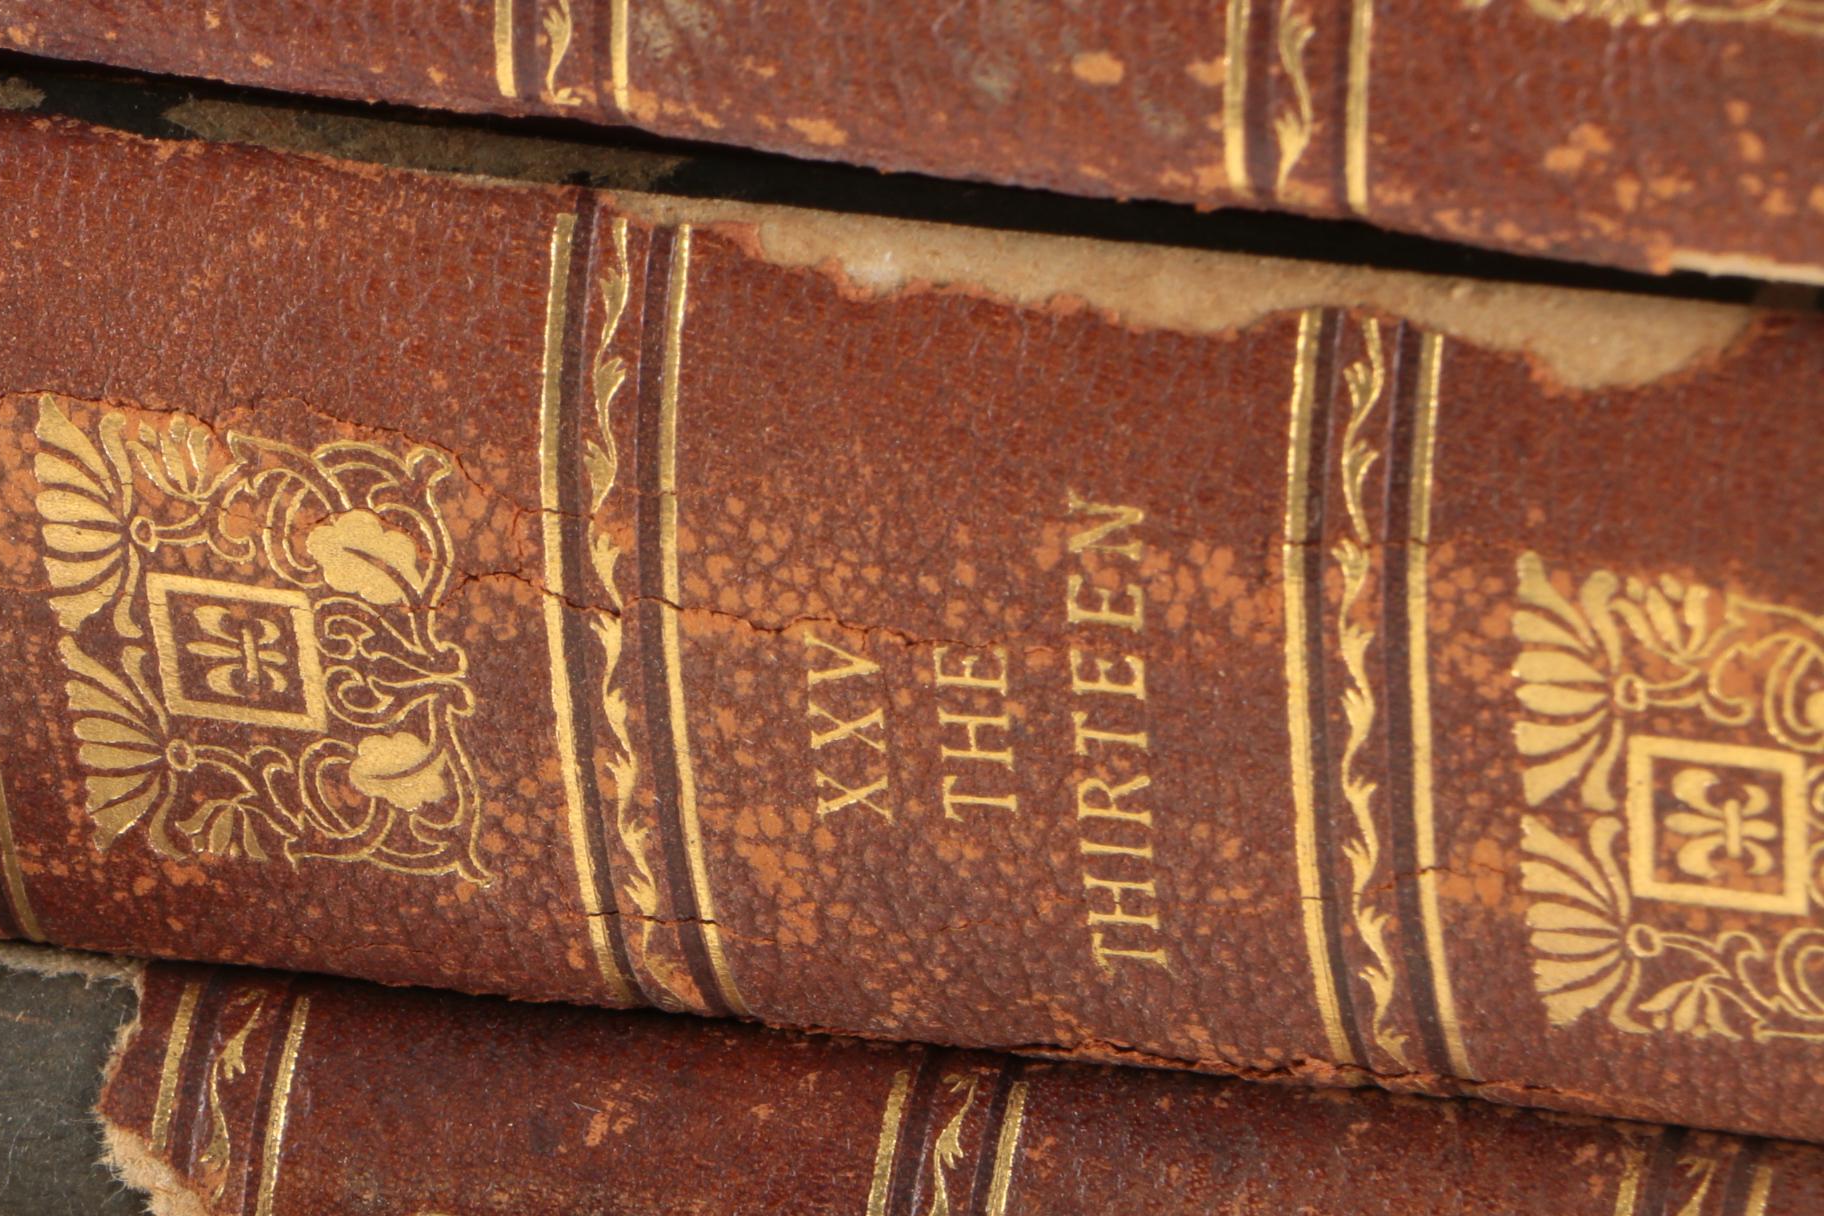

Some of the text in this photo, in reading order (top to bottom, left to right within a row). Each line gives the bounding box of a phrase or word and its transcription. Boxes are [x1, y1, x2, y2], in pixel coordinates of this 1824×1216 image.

[803, 630, 894, 825] XXV
[933, 643, 1020, 823] THE
[1066, 486, 1170, 974] THIRTEEN
